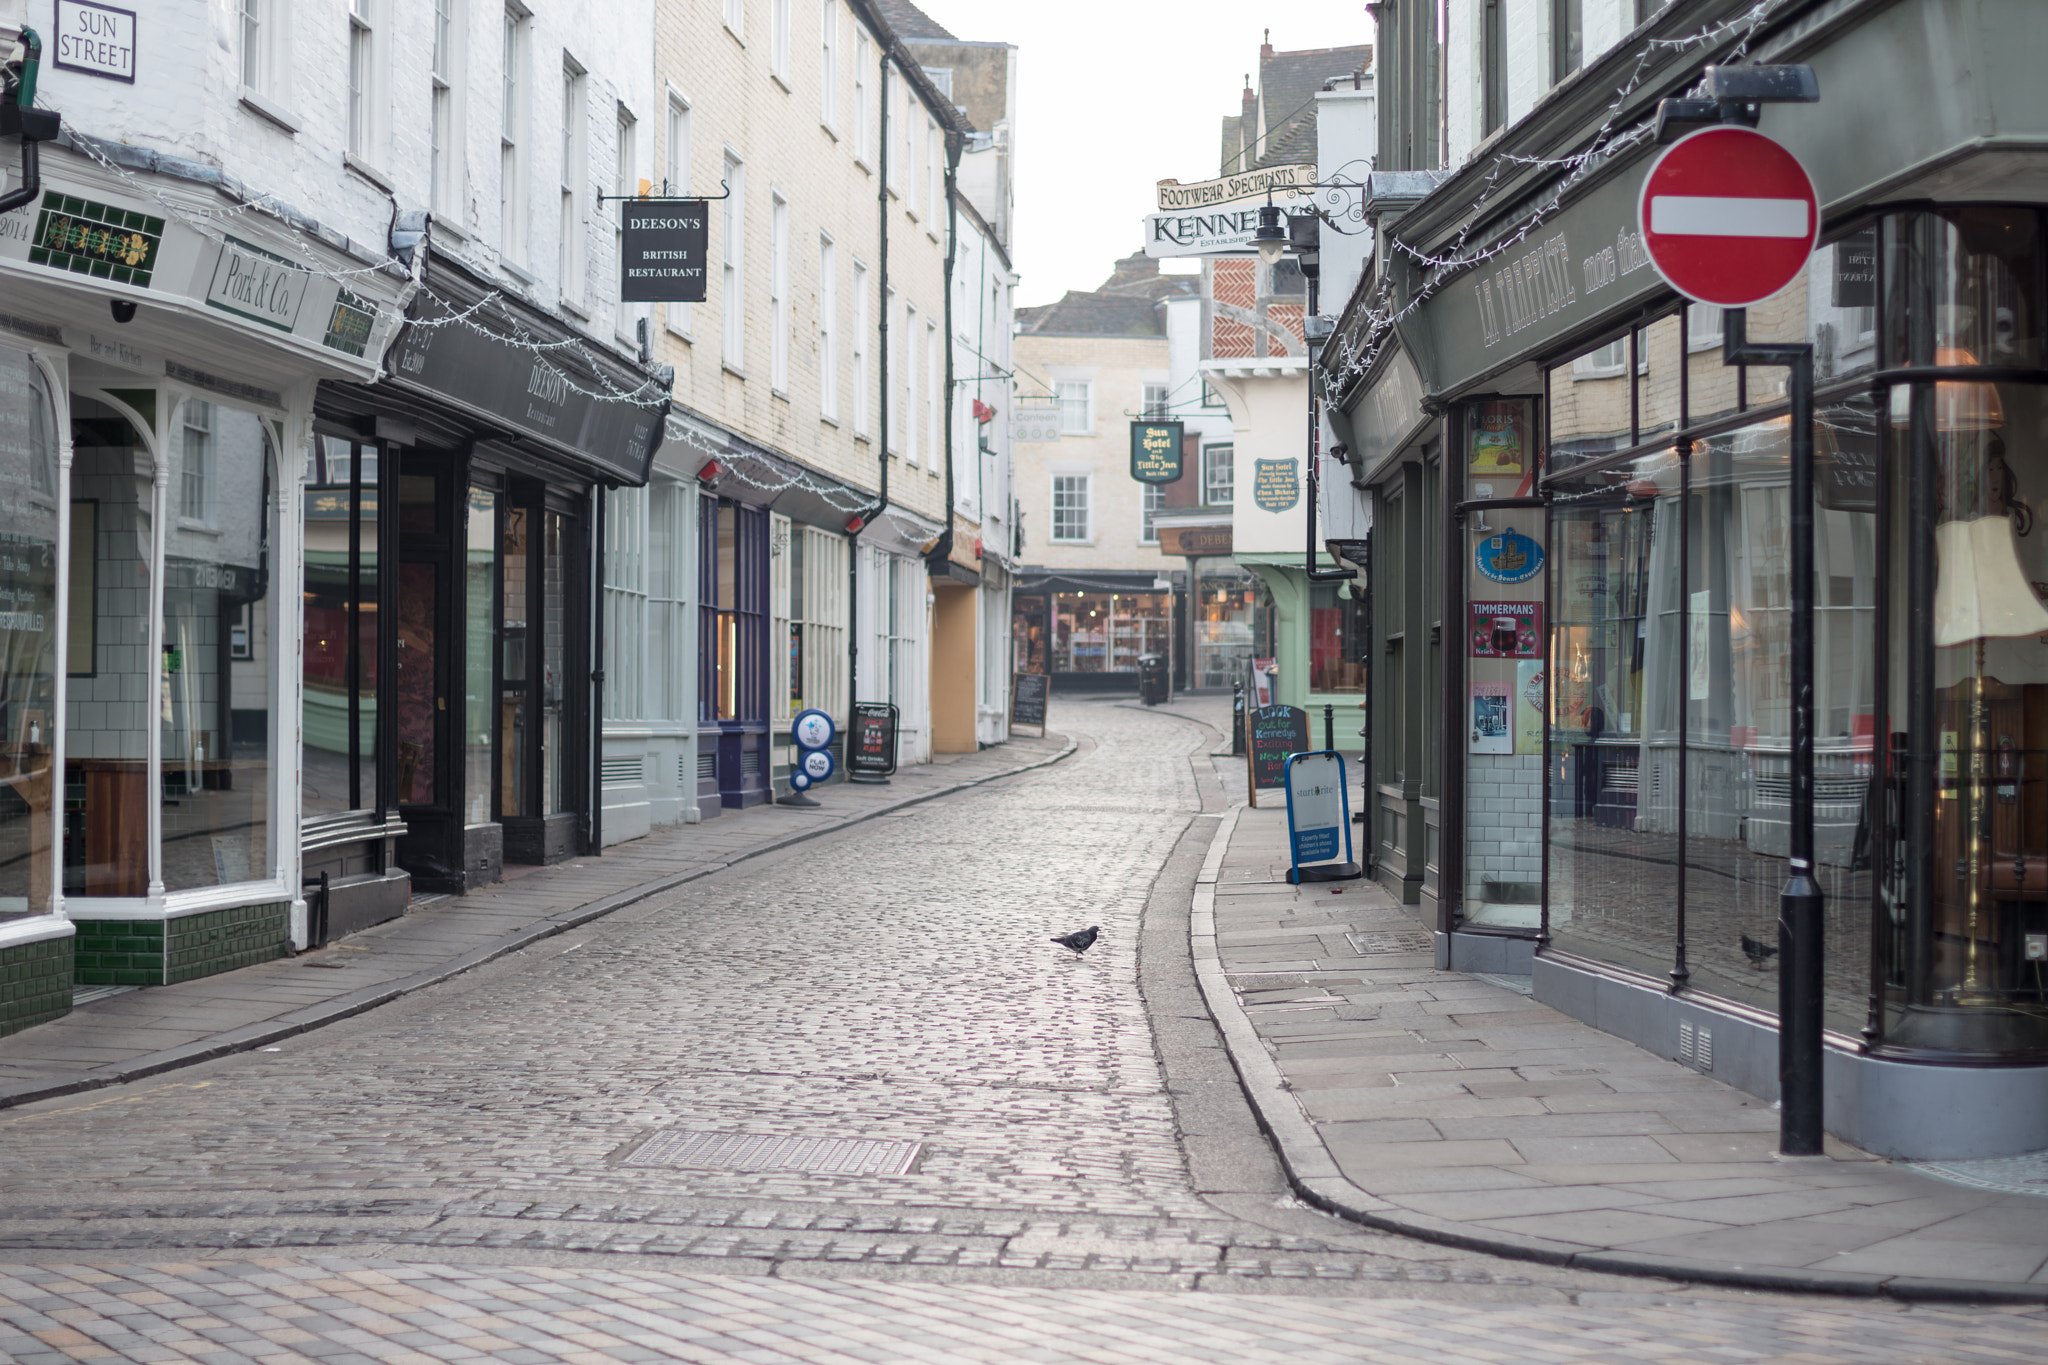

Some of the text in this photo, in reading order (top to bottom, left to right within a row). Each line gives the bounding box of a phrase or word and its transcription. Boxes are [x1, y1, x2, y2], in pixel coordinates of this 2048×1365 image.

[79, 11, 116, 39] SUN
[61, 34, 131, 69] STREET
[1160, 168, 1295, 206] FOOTWEAR SPECIALISTS
[630, 218, 701, 230] DEESON'S
[642, 250, 688, 260] BRITISH
[628, 268, 702, 278] RESTAURANT
[222, 254, 290, 317] Pork & Co.
[1475, 278, 1501, 348] LA
[1495, 232, 1576, 337] TRAPPISTE
[1583, 246, 1616, 295] more
[1015, 412, 1057, 422] Canteen
[1145, 427, 1168, 438] Sun
[1142, 438, 1171, 450] Hotel
[1136, 460, 1177, 471] Little Inn
[1261, 463, 1274, 471] Sun
[16, 558, 31, 577] Away
[1473, 604, 1534, 615] TIMMERMANS
[1259, 706, 1291, 720] LOOK
[1258, 719, 1291, 730] out for
[1256, 729, 1296, 740] Kennedys
[1256, 740, 1293, 752] Exciting
[1260, 752, 1279, 761] New
[810, 763, 825, 771] NOW
